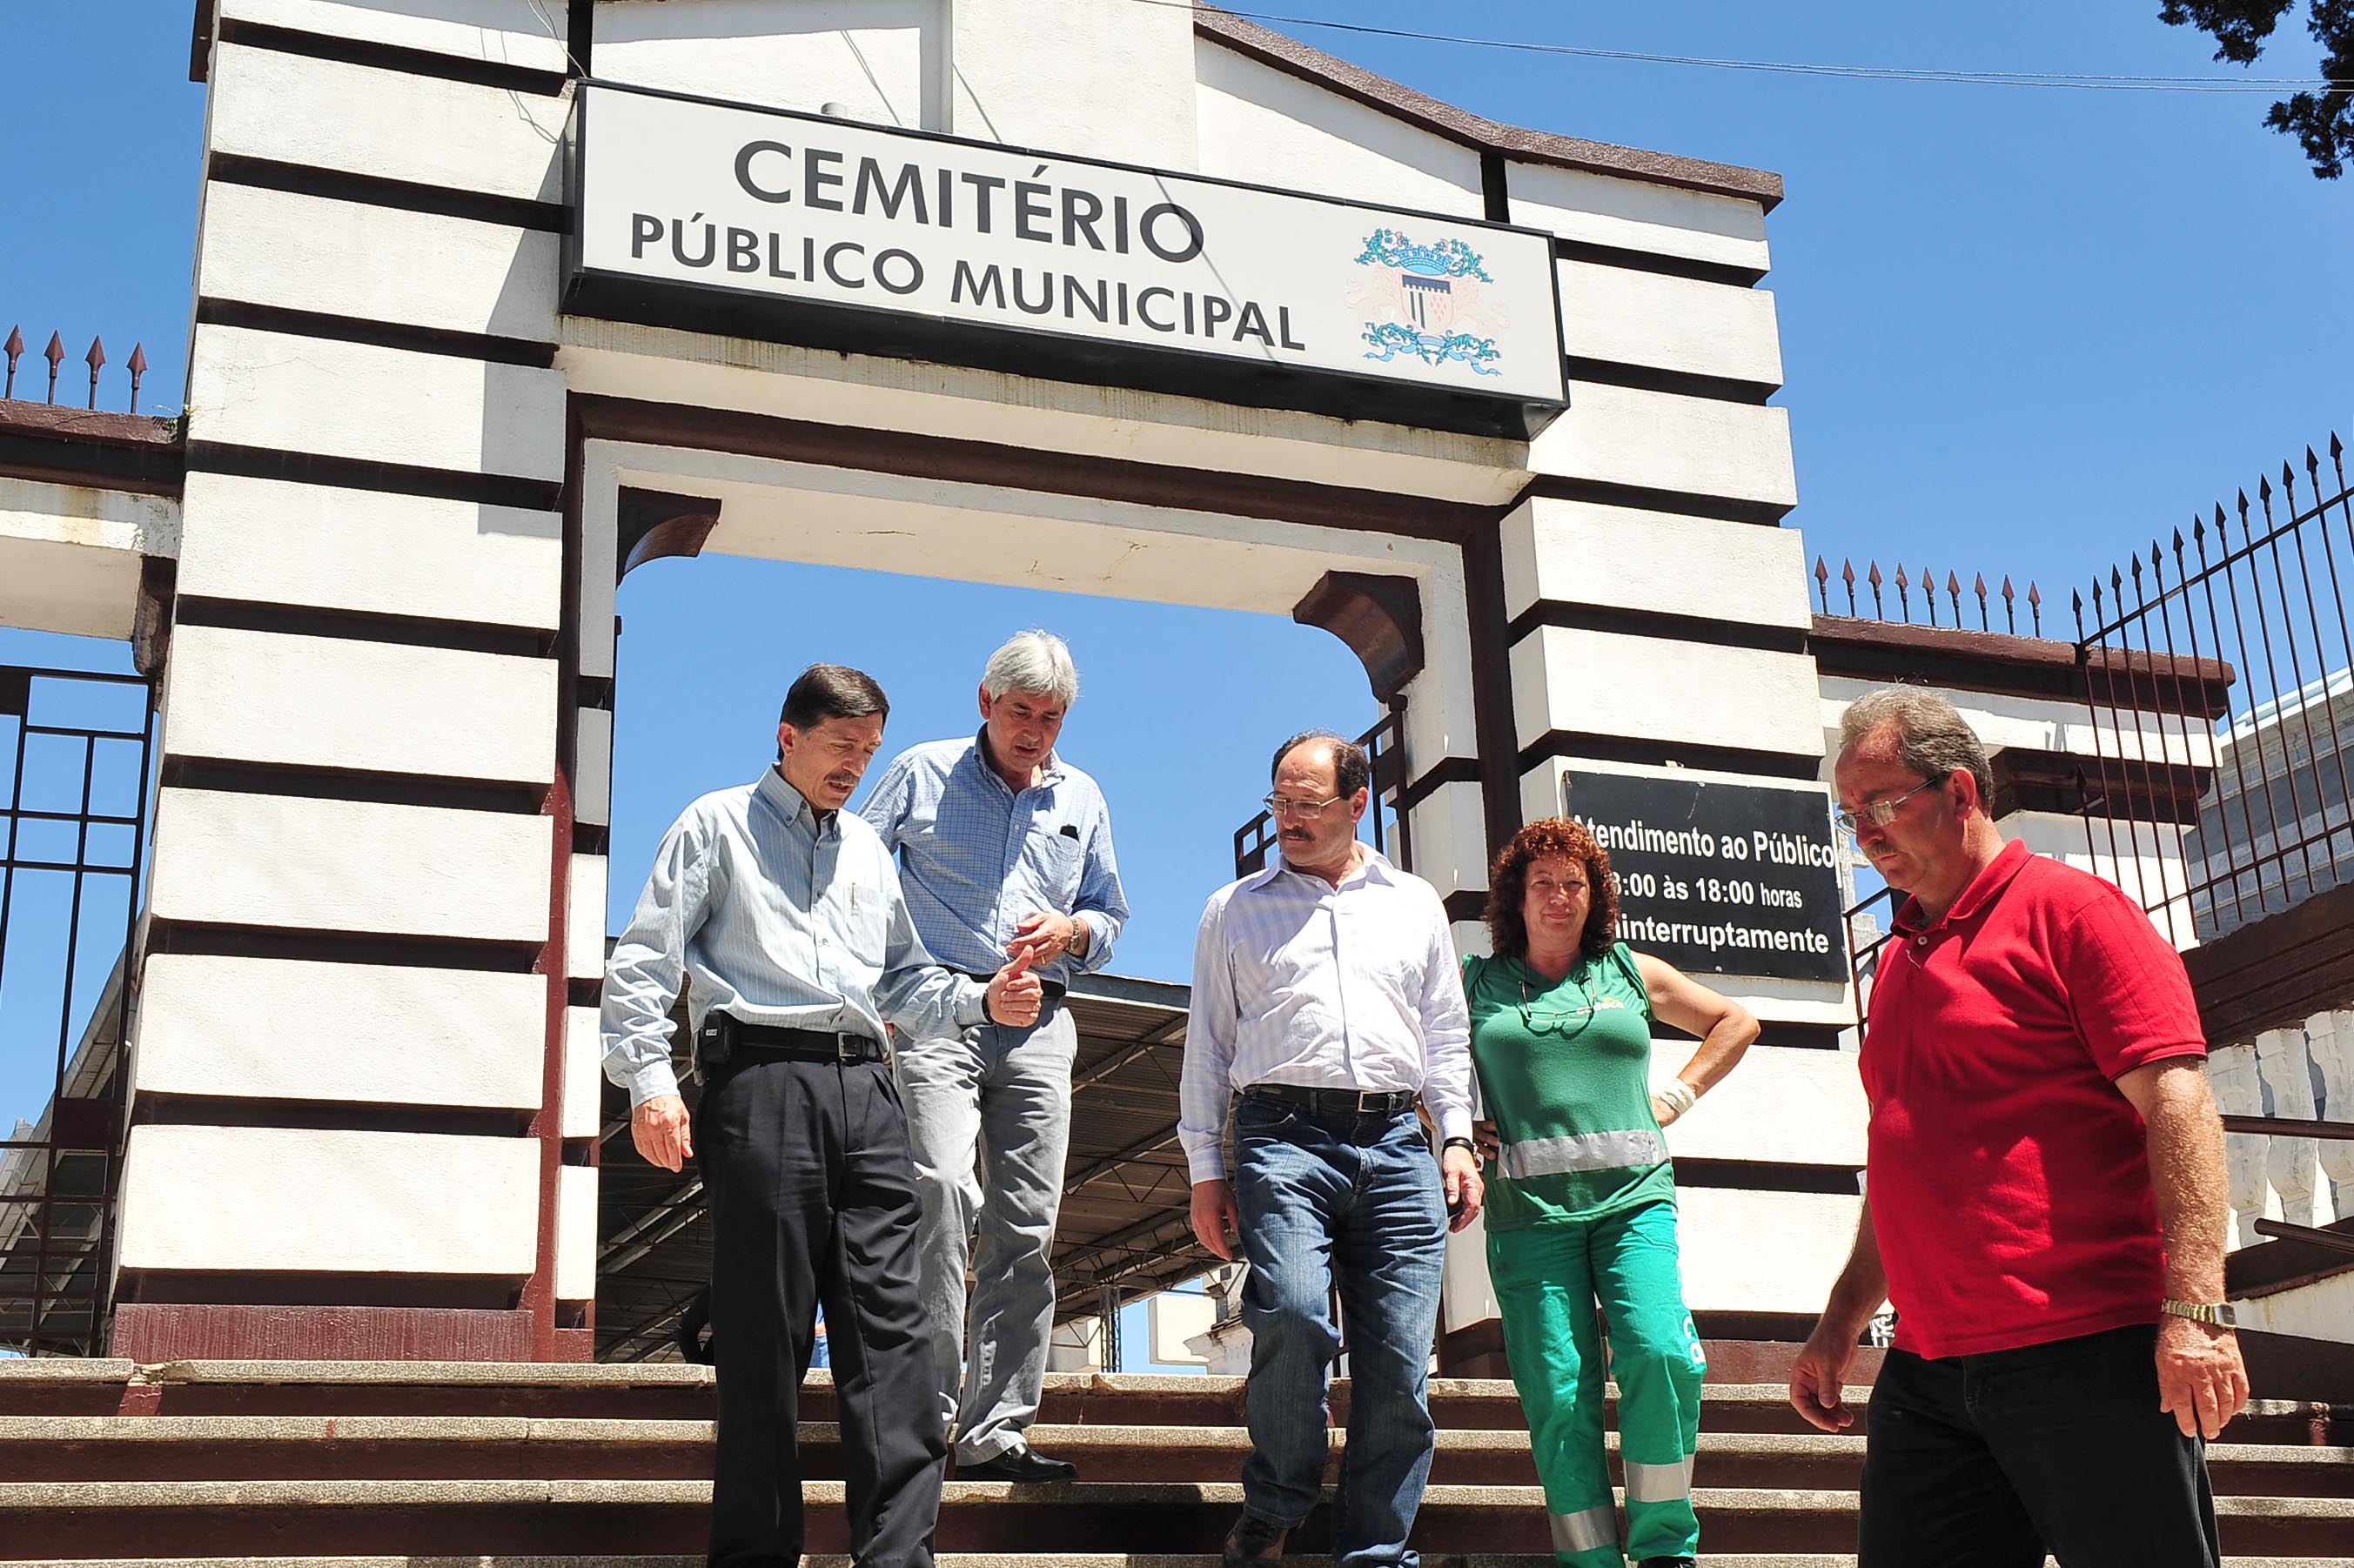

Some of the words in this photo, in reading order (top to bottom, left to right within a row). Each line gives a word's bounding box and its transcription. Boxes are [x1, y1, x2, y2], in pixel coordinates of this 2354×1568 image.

[734, 140, 1204, 264] CEMITÉRIO
[631, 211, 924, 295] PÚBLICO
[950, 259, 1305, 352] MUNICIPAL
[1720, 835, 1748, 861] ao
[1753, 830, 1835, 868] Público
[1663, 874, 1689, 901] às
[1696, 877, 1754, 905] 18:00
[1760, 883, 1803, 908] horas
